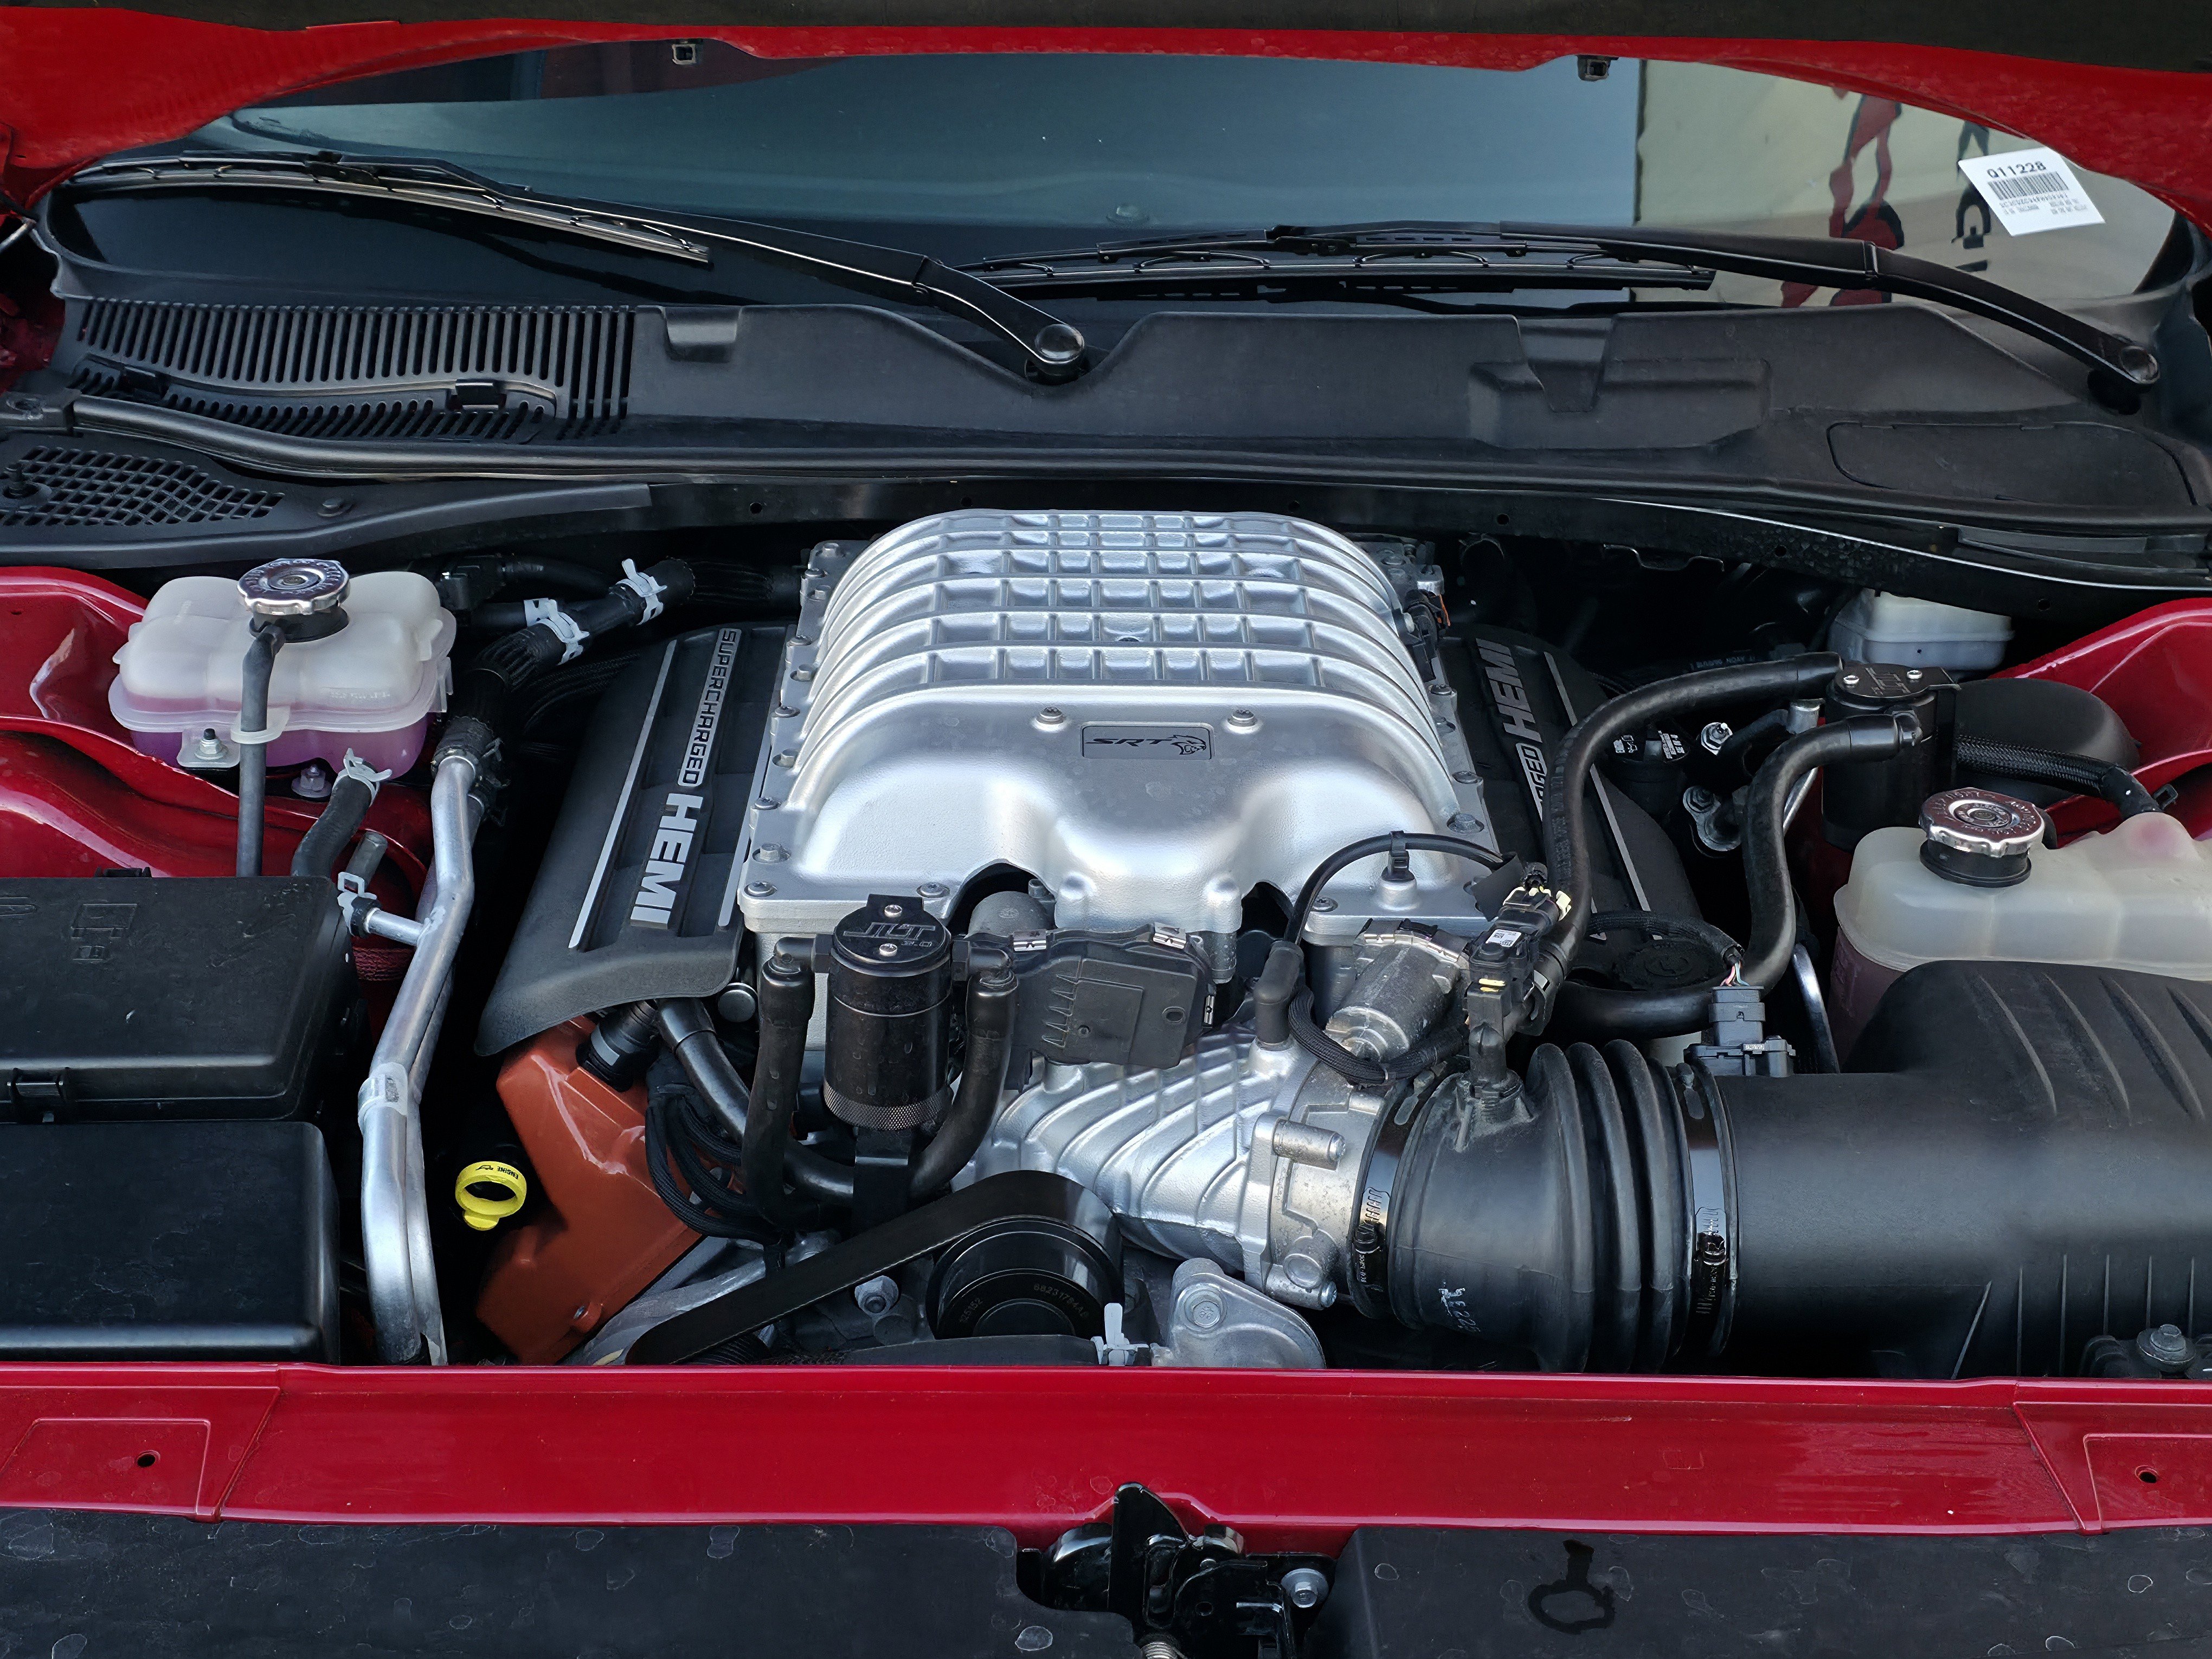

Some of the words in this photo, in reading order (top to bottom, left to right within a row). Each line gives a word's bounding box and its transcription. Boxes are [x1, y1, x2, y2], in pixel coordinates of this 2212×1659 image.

[681, 630, 738, 786] SUPERCHARGED
[1085, 738, 1172, 747] SRT
[1476, 638, 1543, 743] HEMI
[630, 793, 703, 927] HEMI
